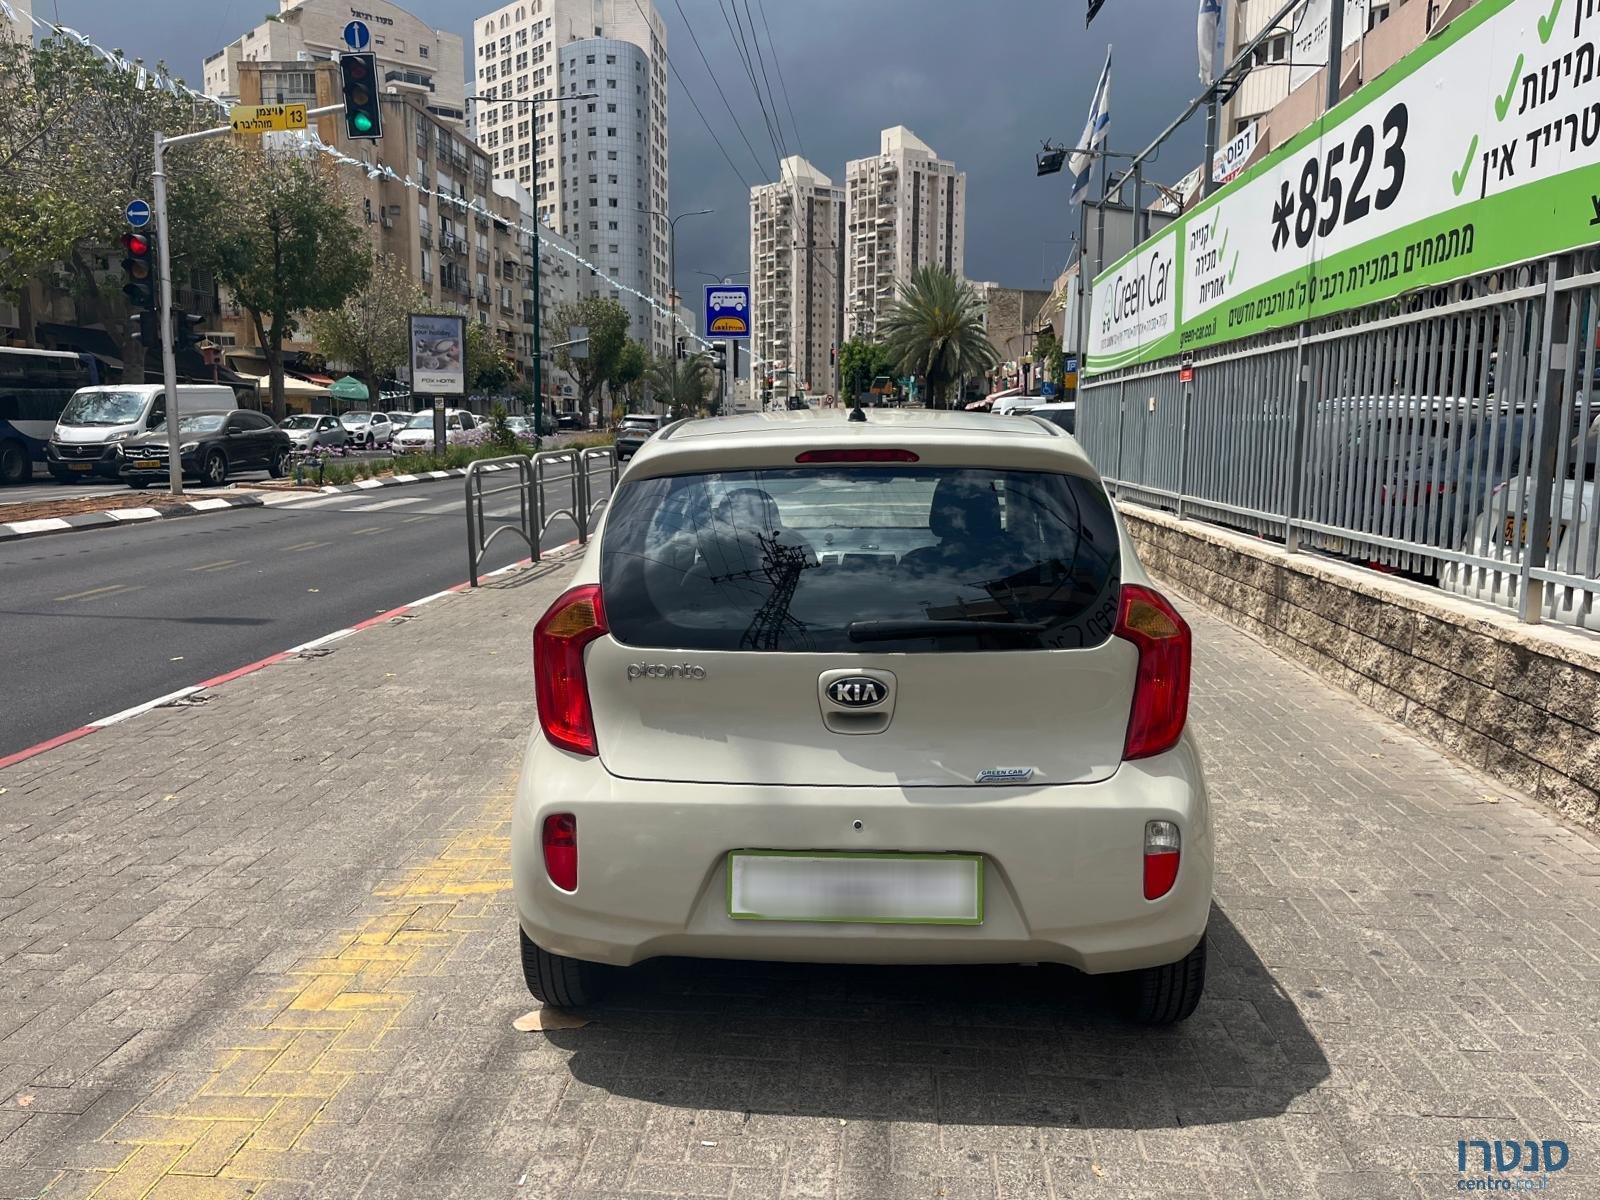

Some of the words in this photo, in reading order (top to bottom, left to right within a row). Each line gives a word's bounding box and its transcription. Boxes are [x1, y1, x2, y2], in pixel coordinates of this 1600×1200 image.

[1518, 42, 1600, 116] מינות
[240, 119, 273, 129] מוהליבר
[256, 107, 278, 120] ויצמן
[290, 110, 303, 123] 13
[1227, 131, 1251, 165] דפוס
[1480, 138, 1518, 200] אין
[1190, 223, 1210, 251] קנייה
[1403, 223, 1474, 274] מתמחים
[1195, 248, 1217, 277] מכירה
[1346, 250, 1399, 293] במכירת
[1113, 275, 1146, 324] Green
[1147, 251, 1172, 308] Car
[1199, 274, 1226, 304] אחריות
[1309, 276, 1317, 304] 0
[1320, 270, 1345, 300] רכבי
[1228, 302, 1255, 328] חדשים
[1256, 291, 1285, 319] ורכבים
[1180, 317, 1217, 349] green-car.co.il
[421, 377, 435, 385] FOX
[436, 377, 456, 385] HOME
[627, 660, 707, 682] picanto
[837, 683, 879, 701] KIA
